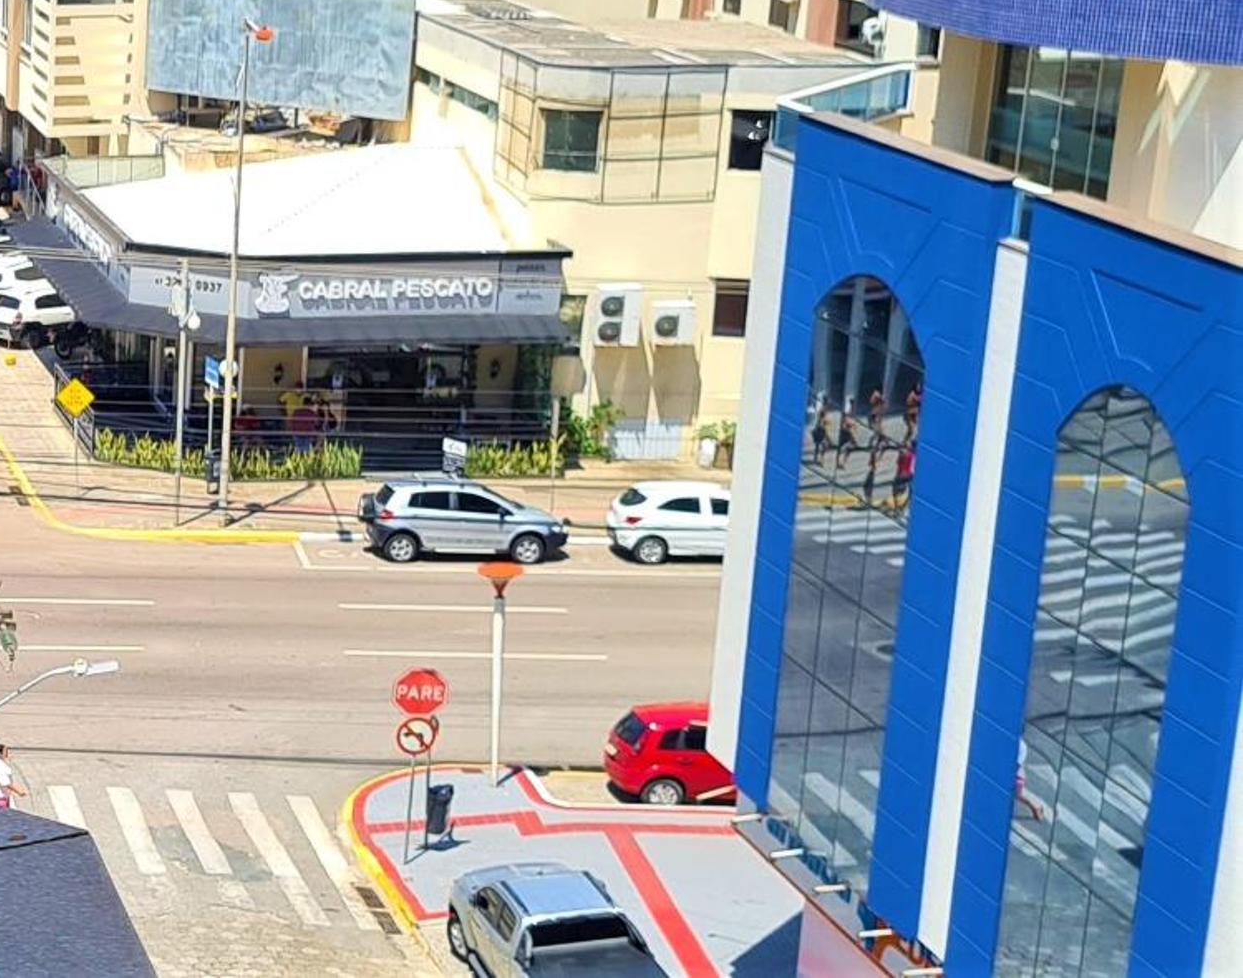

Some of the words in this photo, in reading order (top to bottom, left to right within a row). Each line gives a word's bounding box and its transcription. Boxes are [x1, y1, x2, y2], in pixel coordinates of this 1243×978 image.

[298, 279, 387, 300] CABRAL
[392, 277, 493, 298] PESCATO
[397, 684, 443, 702] PARE
